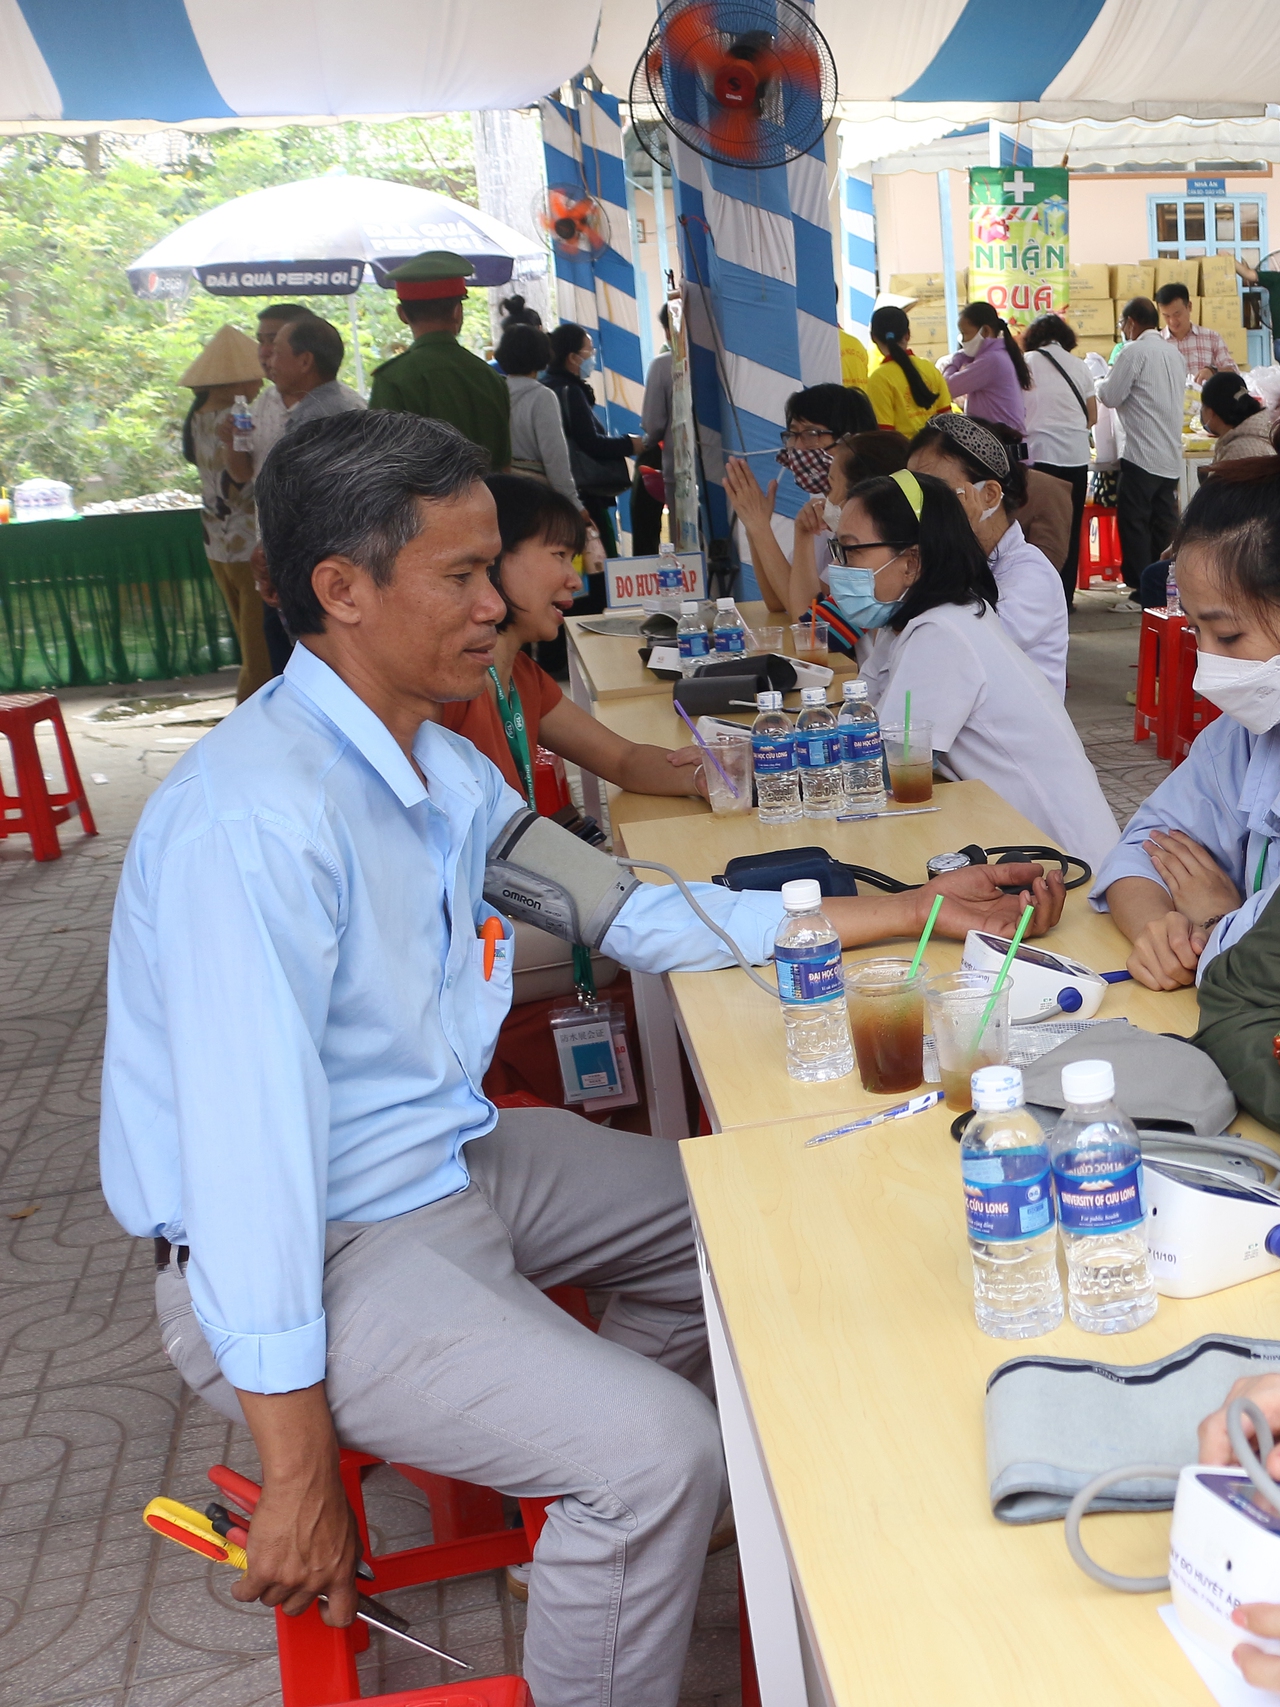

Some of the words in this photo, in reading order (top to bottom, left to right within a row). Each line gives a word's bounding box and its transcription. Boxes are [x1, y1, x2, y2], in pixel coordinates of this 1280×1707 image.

[975, 238, 1065, 276] NHẬN
[241, 271, 275, 287] QUÁ
[986, 278, 1053, 312] QUÀ
[615, 575, 634, 599] ĐO
[635, 571, 661, 597] HUY
[502, 889, 541, 911] OMRON
[821, 968, 834, 980] HỌC
[969, 1198, 984, 1213] CỬU
[985, 1202, 1009, 1214] LONG
[1061, 1191, 1094, 1207] UNIVERSITY
[1094, 1194, 1105, 1207] OF
[1120, 1185, 1136, 1201] LONG
[1152, 1250, 1177, 1264] (1/10)
